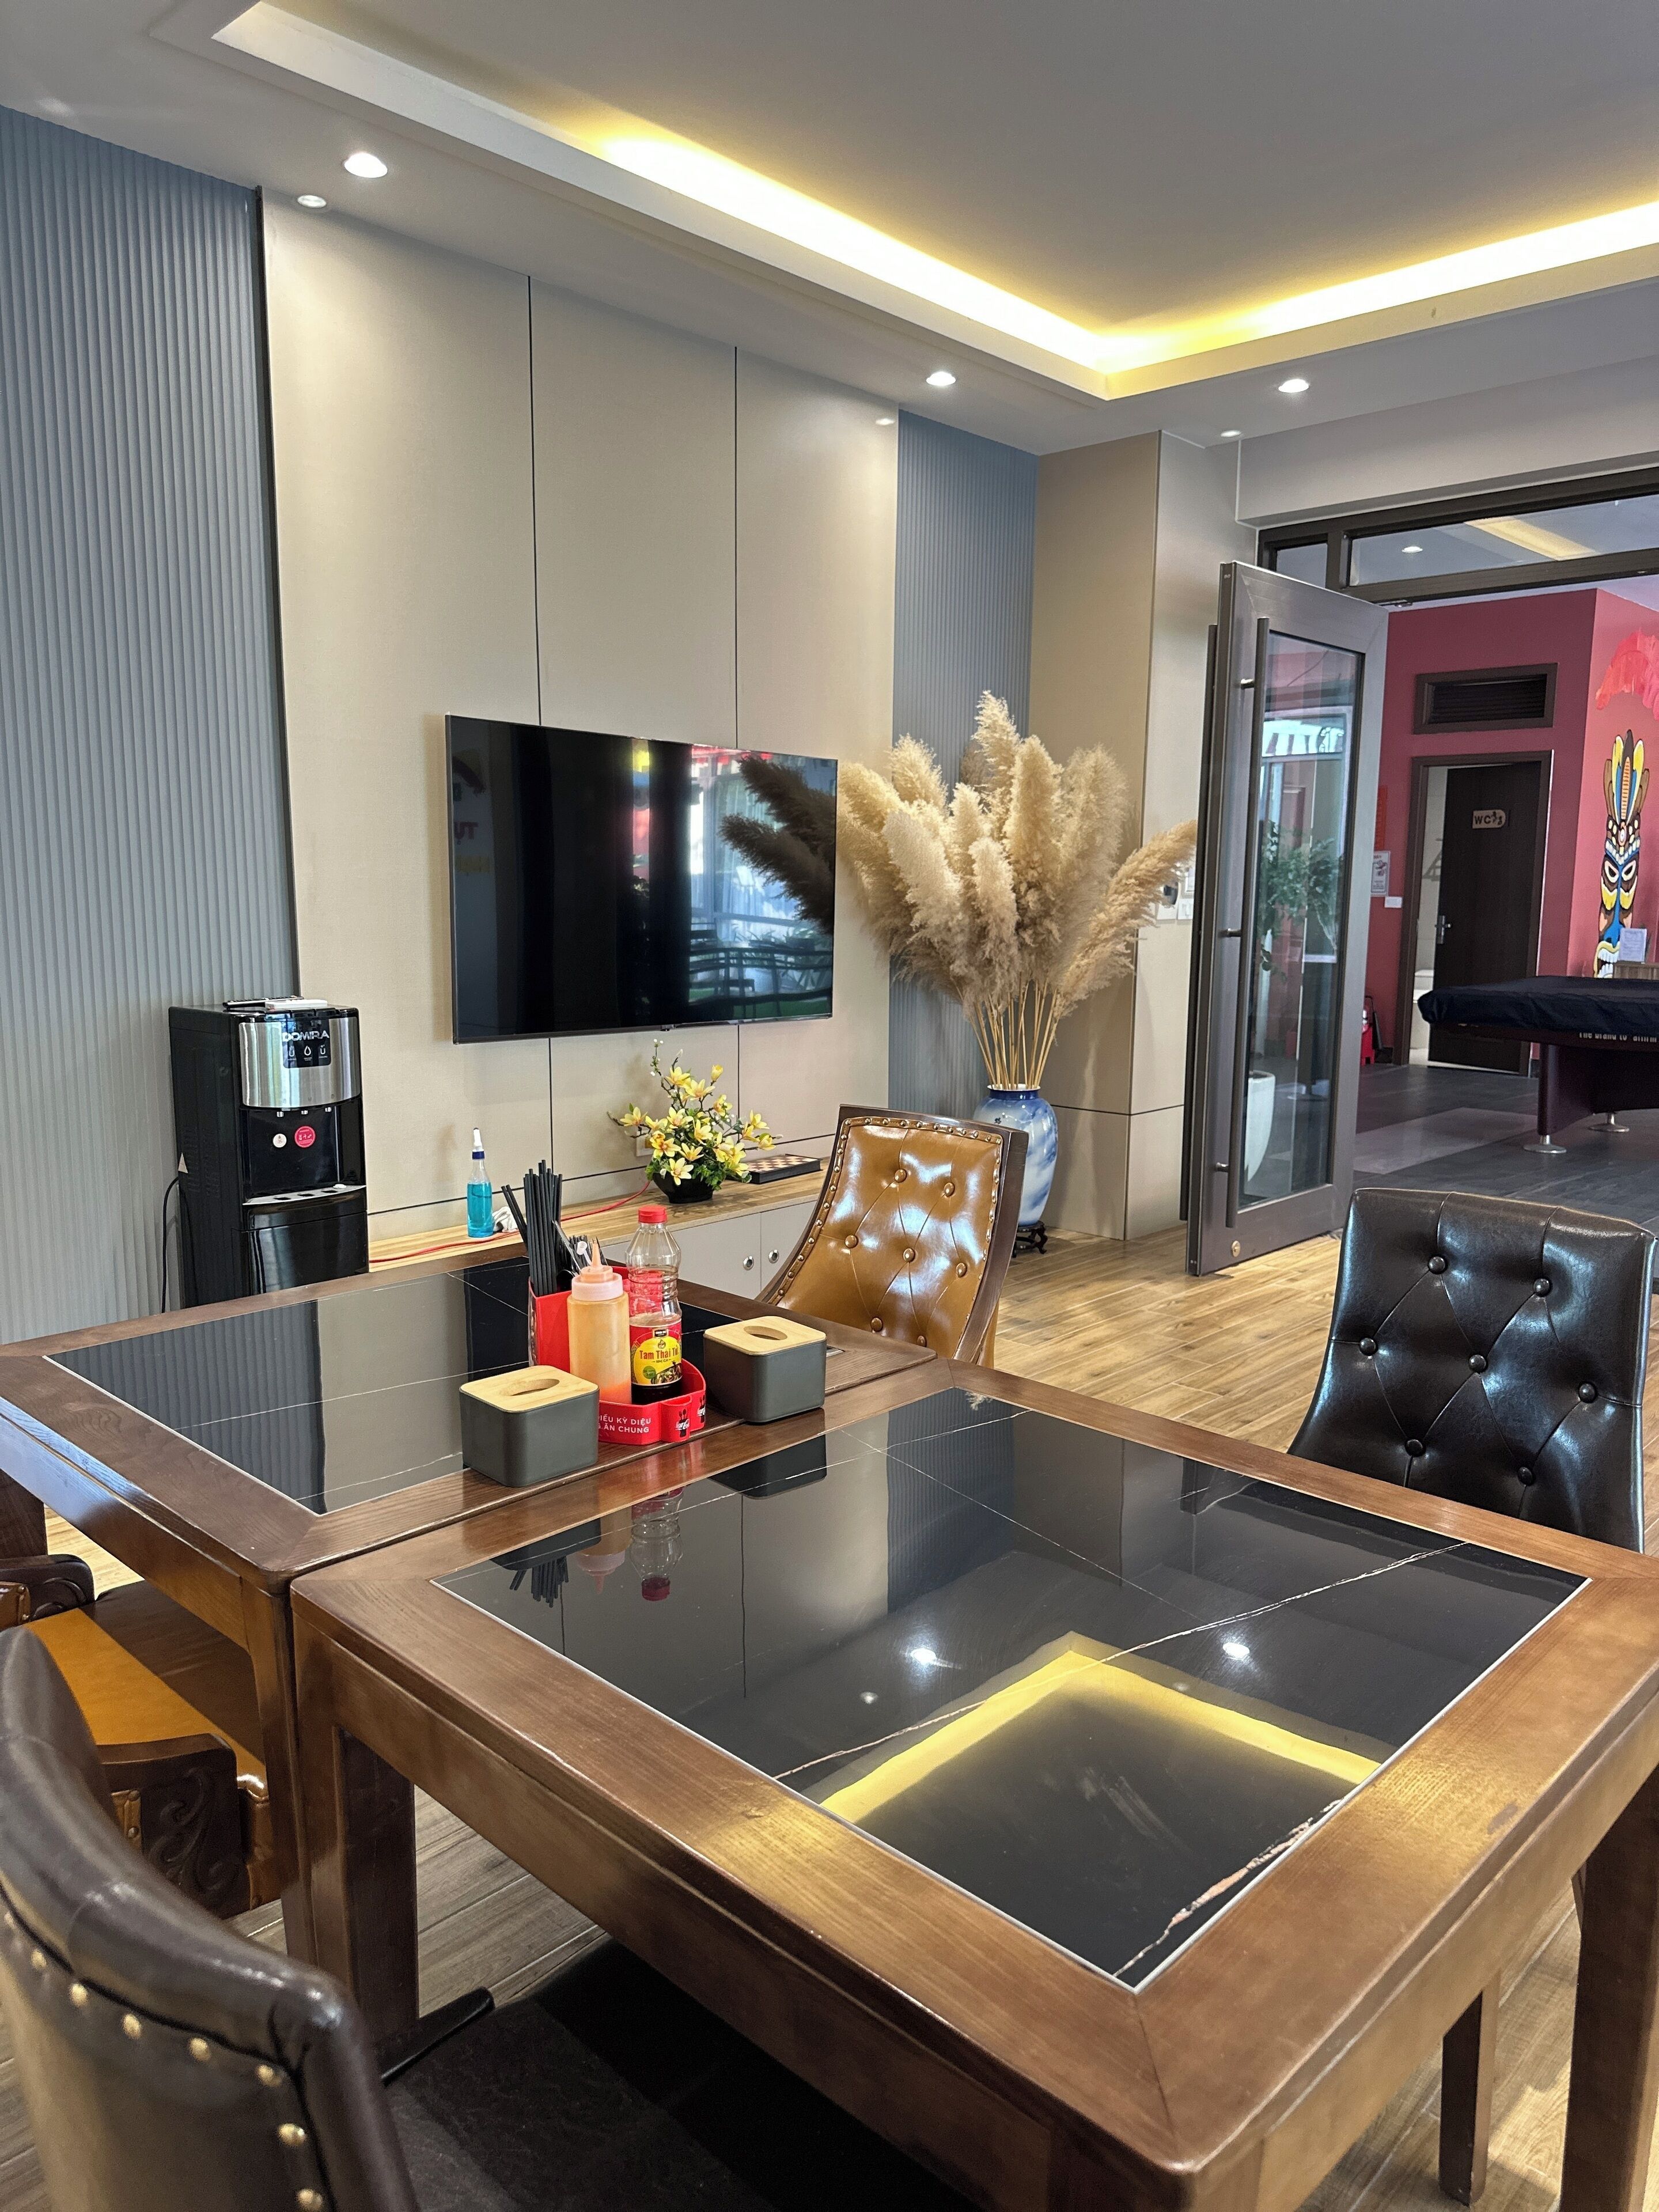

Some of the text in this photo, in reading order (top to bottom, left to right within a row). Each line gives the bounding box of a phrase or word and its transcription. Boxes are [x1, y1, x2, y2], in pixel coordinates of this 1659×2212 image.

[1475, 815, 1491, 825] WC
[282, 1030, 330, 1042] DOMIRA
[639, 1350, 654, 1360] Tam
